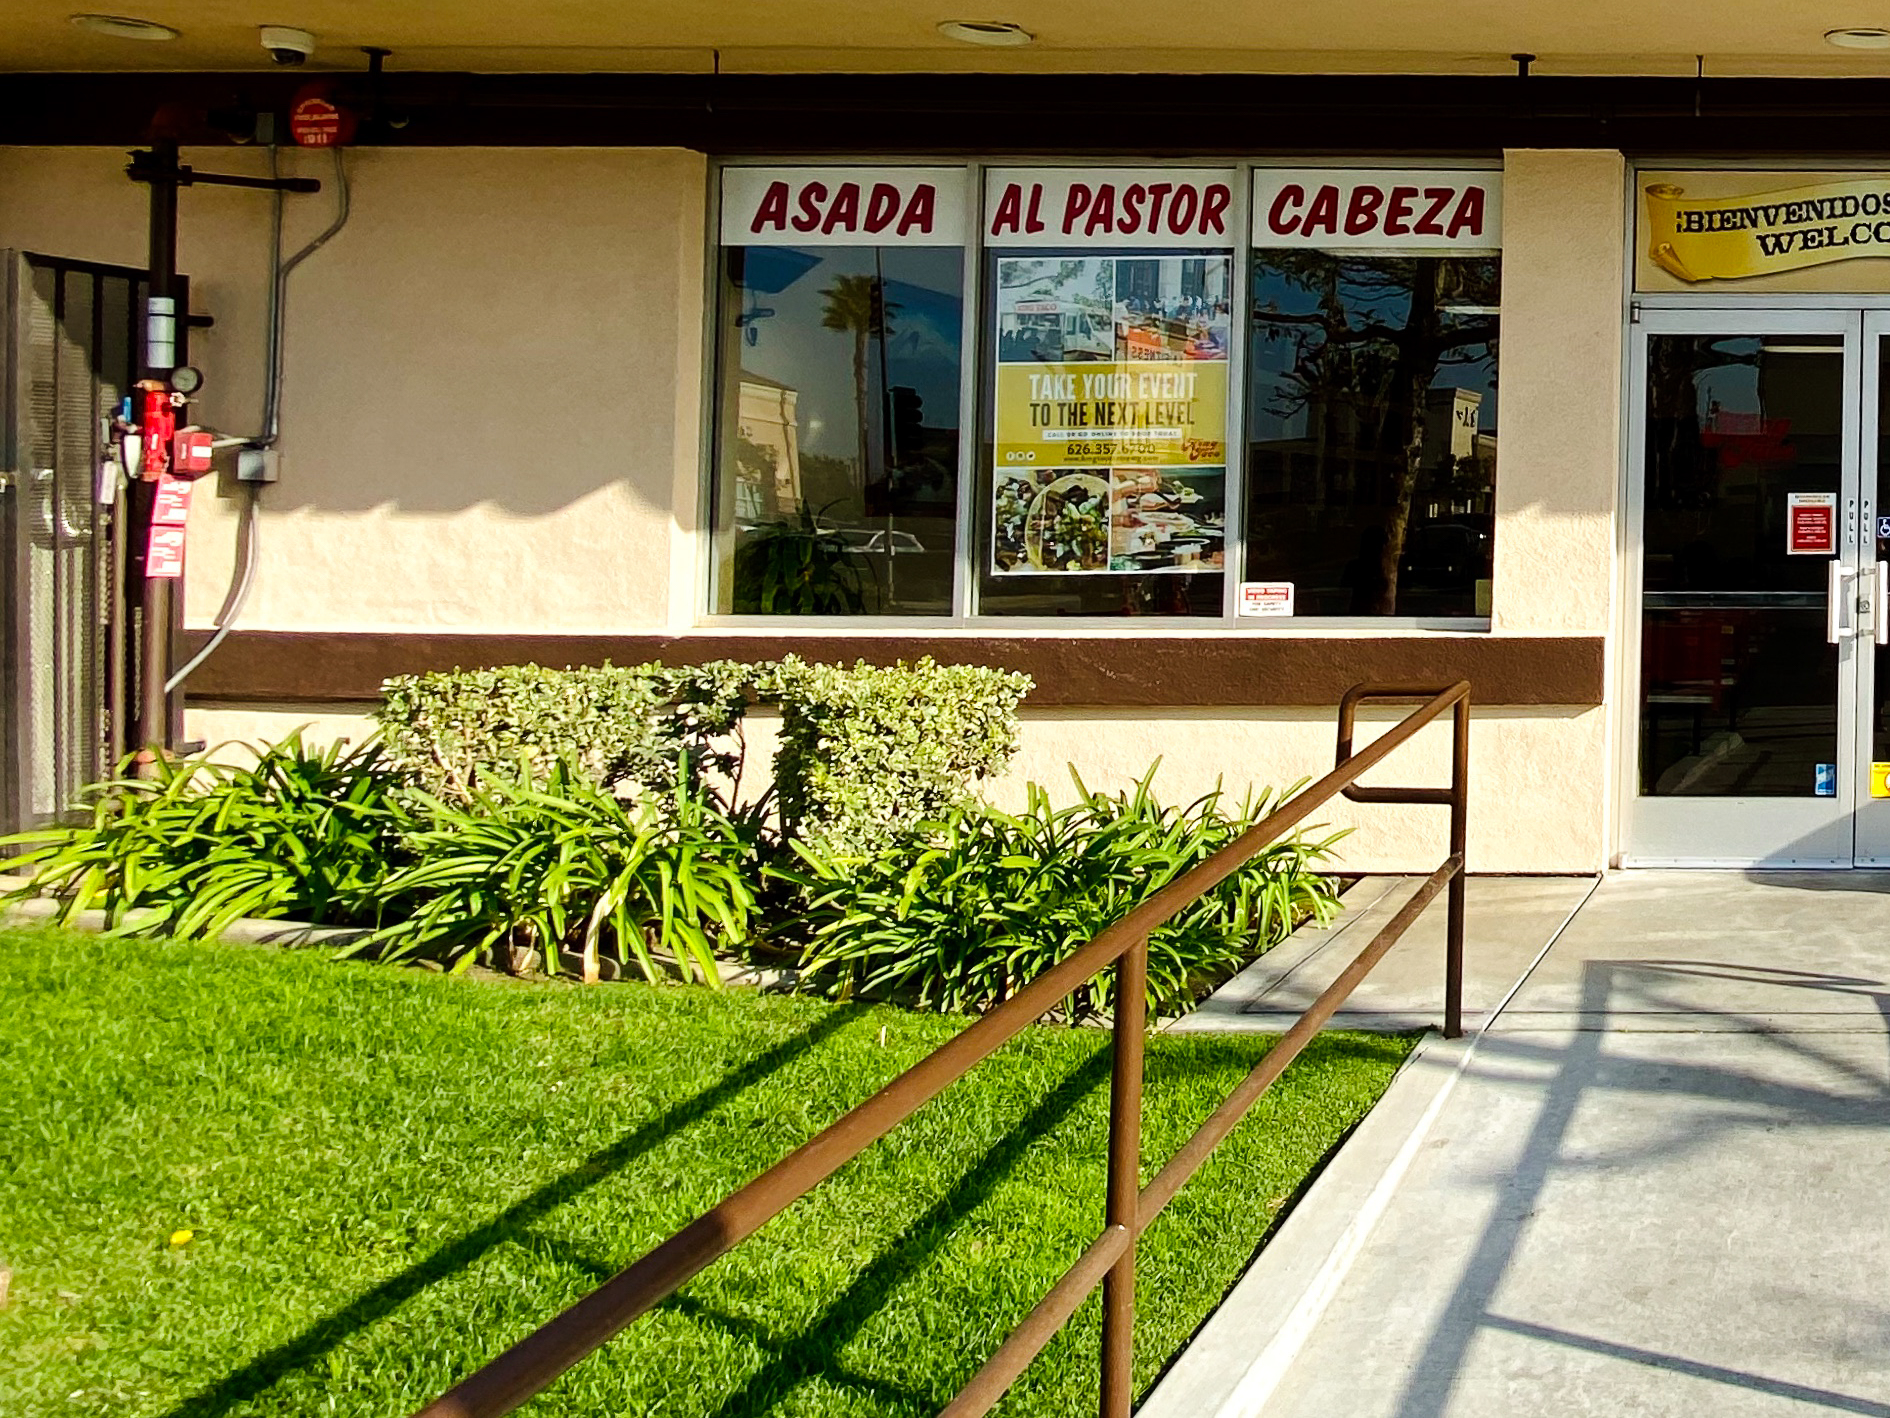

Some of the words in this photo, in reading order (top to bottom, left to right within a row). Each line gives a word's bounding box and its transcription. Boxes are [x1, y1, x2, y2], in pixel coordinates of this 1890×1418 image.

[750, 182, 936, 236] ASADA
[991, 183, 1046, 235] AL
[1061, 183, 1231, 236] PASTOR
[1267, 184, 1486, 238] CABEZA
[1029, 373, 1076, 401] TAKE
[1083, 373, 1132, 401] YOUR
[1138, 372, 1198, 400] EVENT
[1029, 402, 1050, 427] TO
[1057, 401, 1088, 427] THE
[1094, 401, 1139, 426] NEXT
[1144, 401, 1196, 426] LEVEL
